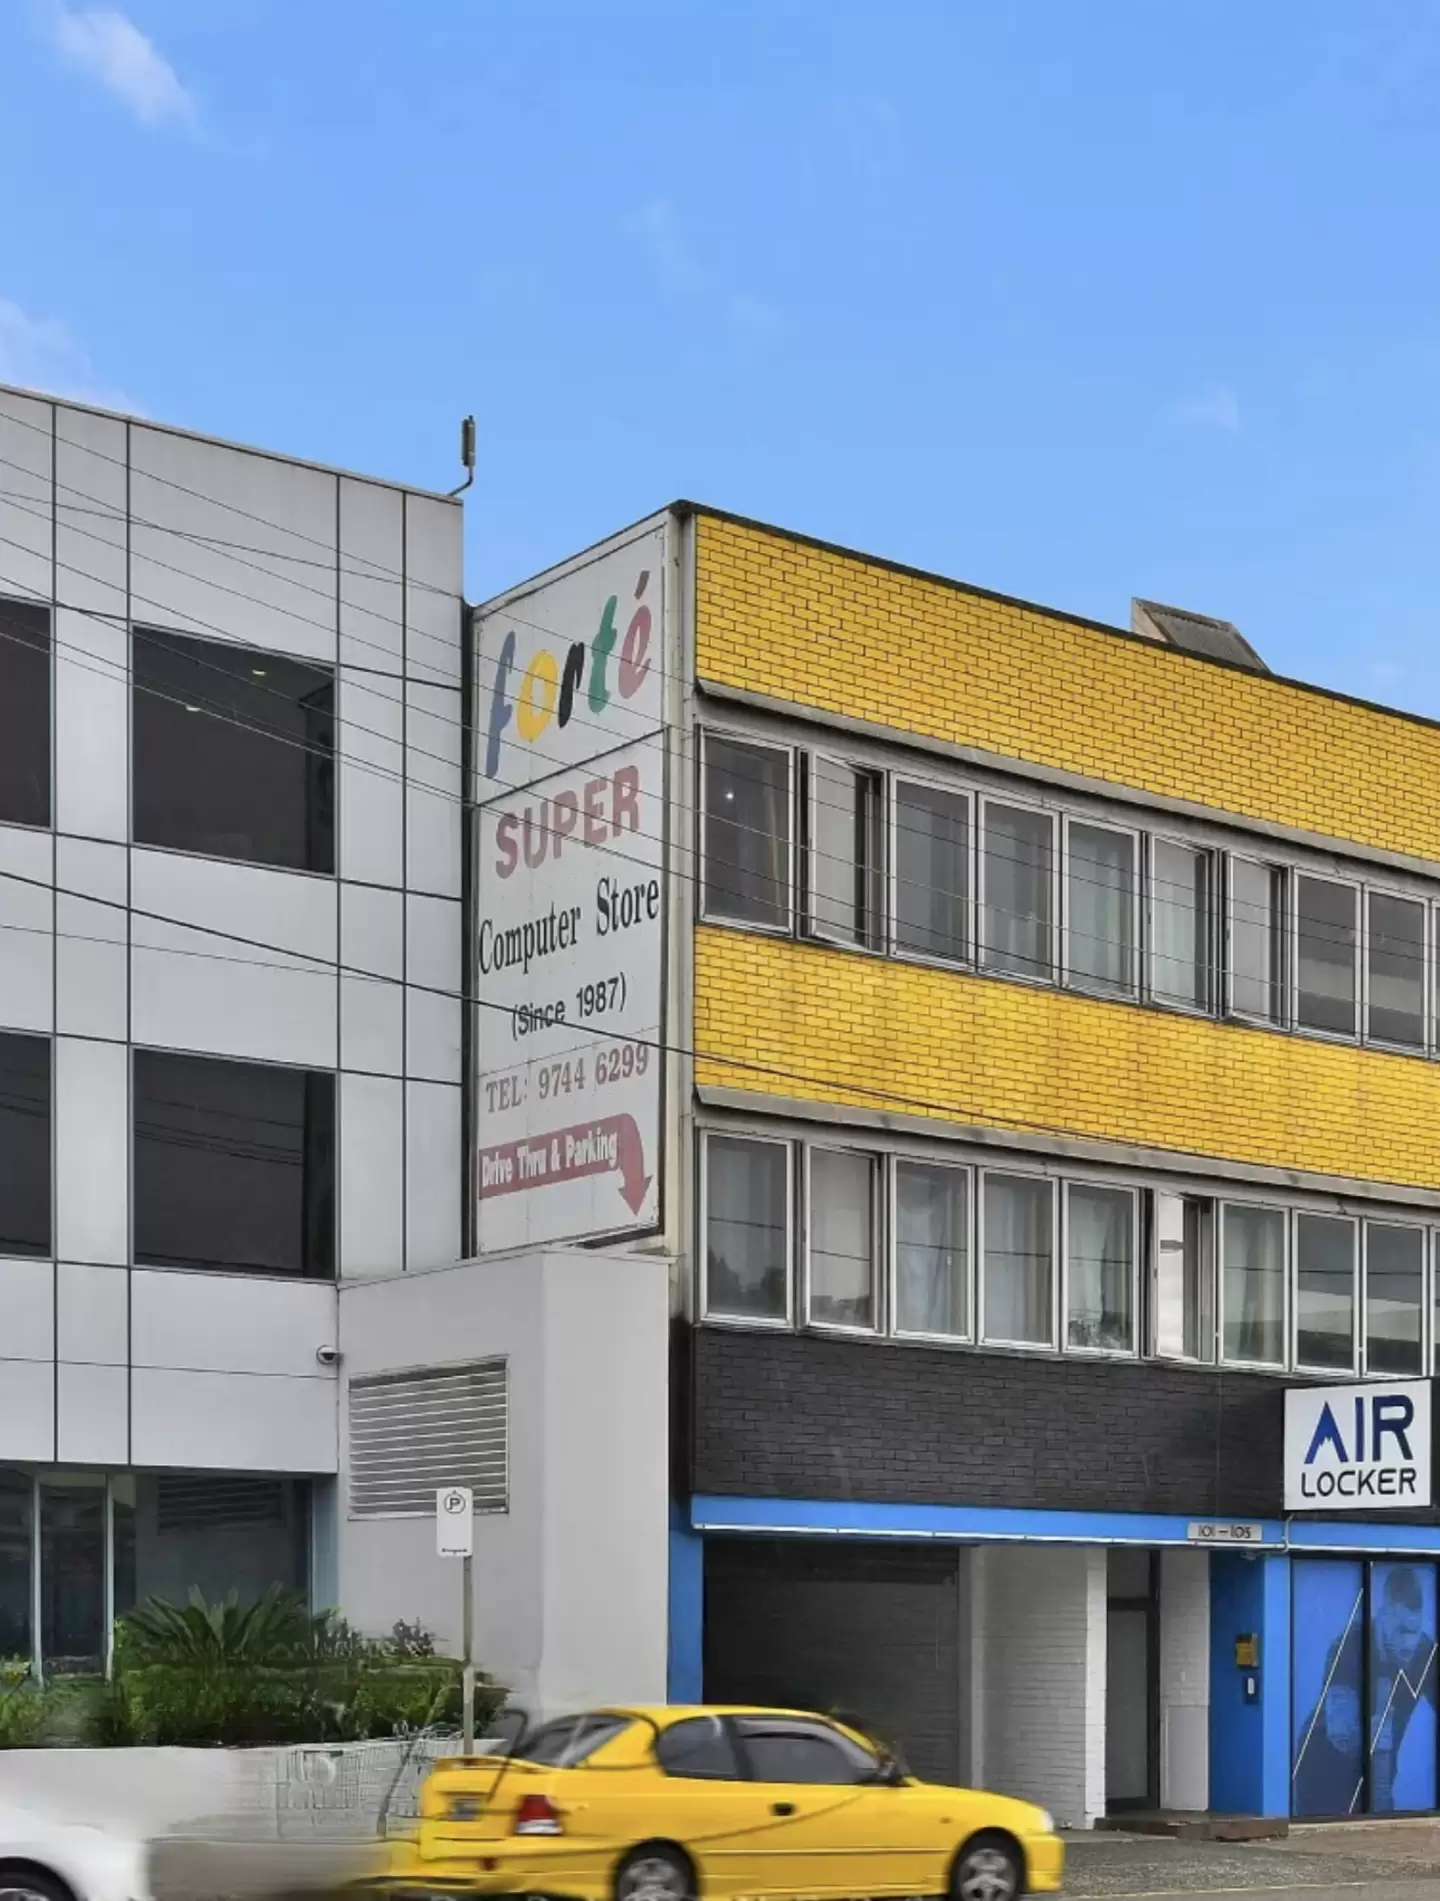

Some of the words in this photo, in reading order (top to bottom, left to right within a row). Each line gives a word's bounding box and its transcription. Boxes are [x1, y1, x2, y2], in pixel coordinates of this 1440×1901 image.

[485, 570, 652, 779] forté
[495, 765, 639, 879] SUPER
[479, 901, 581, 975] Computer
[596, 875, 660, 937] Store
[511, 1000, 566, 1041] (Since
[576, 972, 627, 1018] 1987)
[486, 1075, 528, 1113] TEL:
[539, 1057, 585, 1099] 9744
[595, 1043, 649, 1086] 6299
[482, 1152, 513, 1188] Drive
[517, 1145, 547, 1180] Thru
[551, 1138, 561, 1172] &
[566, 1127, 618, 1169] Parking
[1303, 1394, 1415, 1465] AIR
[1301, 1467, 1417, 1498] LOCKER
